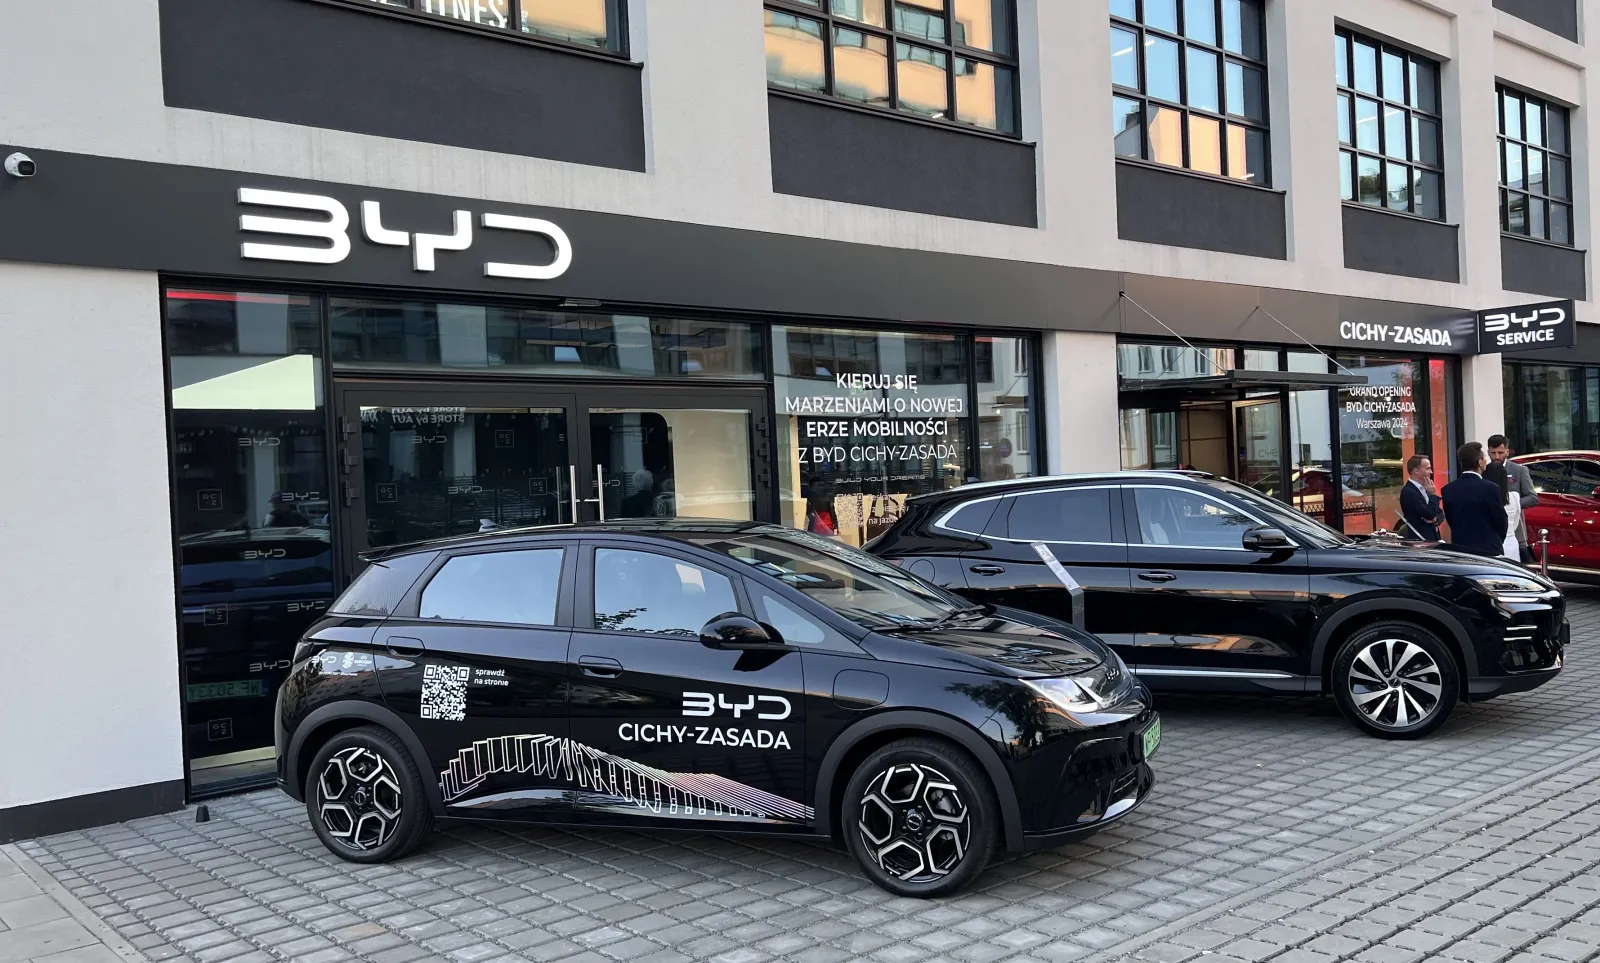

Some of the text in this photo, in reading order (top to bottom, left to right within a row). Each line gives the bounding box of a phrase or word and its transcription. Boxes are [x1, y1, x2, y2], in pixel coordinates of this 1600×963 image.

[237, 187, 572, 279] BYD
[1484, 307, 1566, 332] BYD
[1340, 321, 1452, 347] CICHY-ZASADA
[1496, 328, 1555, 346] SERVICE
[836, 373, 918, 394] KIERUJ SIĘ
[1349, 386, 1412, 397] GRAND OPENING
[785, 397, 963, 413] MARZENIAMI O NOWEJ
[1346, 402, 1416, 413] BYD CICHY-ZASADA
[807, 418, 948, 438] ERZE MOBILNOŚCI
[1356, 417, 1408, 429] Warszawa 2024
[238, 437, 281, 447] BYD
[411, 435, 448, 444] BYD
[798, 444, 958, 464] Z BYD CICHY-ZASADA
[447, 485, 483, 495] BYD
[244, 548, 287, 560] BYD
[249, 660, 291, 673] BYD
[475, 668, 505, 678] sprawdź
[682, 691, 791, 720] BYD
[618, 723, 791, 750] CICHY-ZASADA
